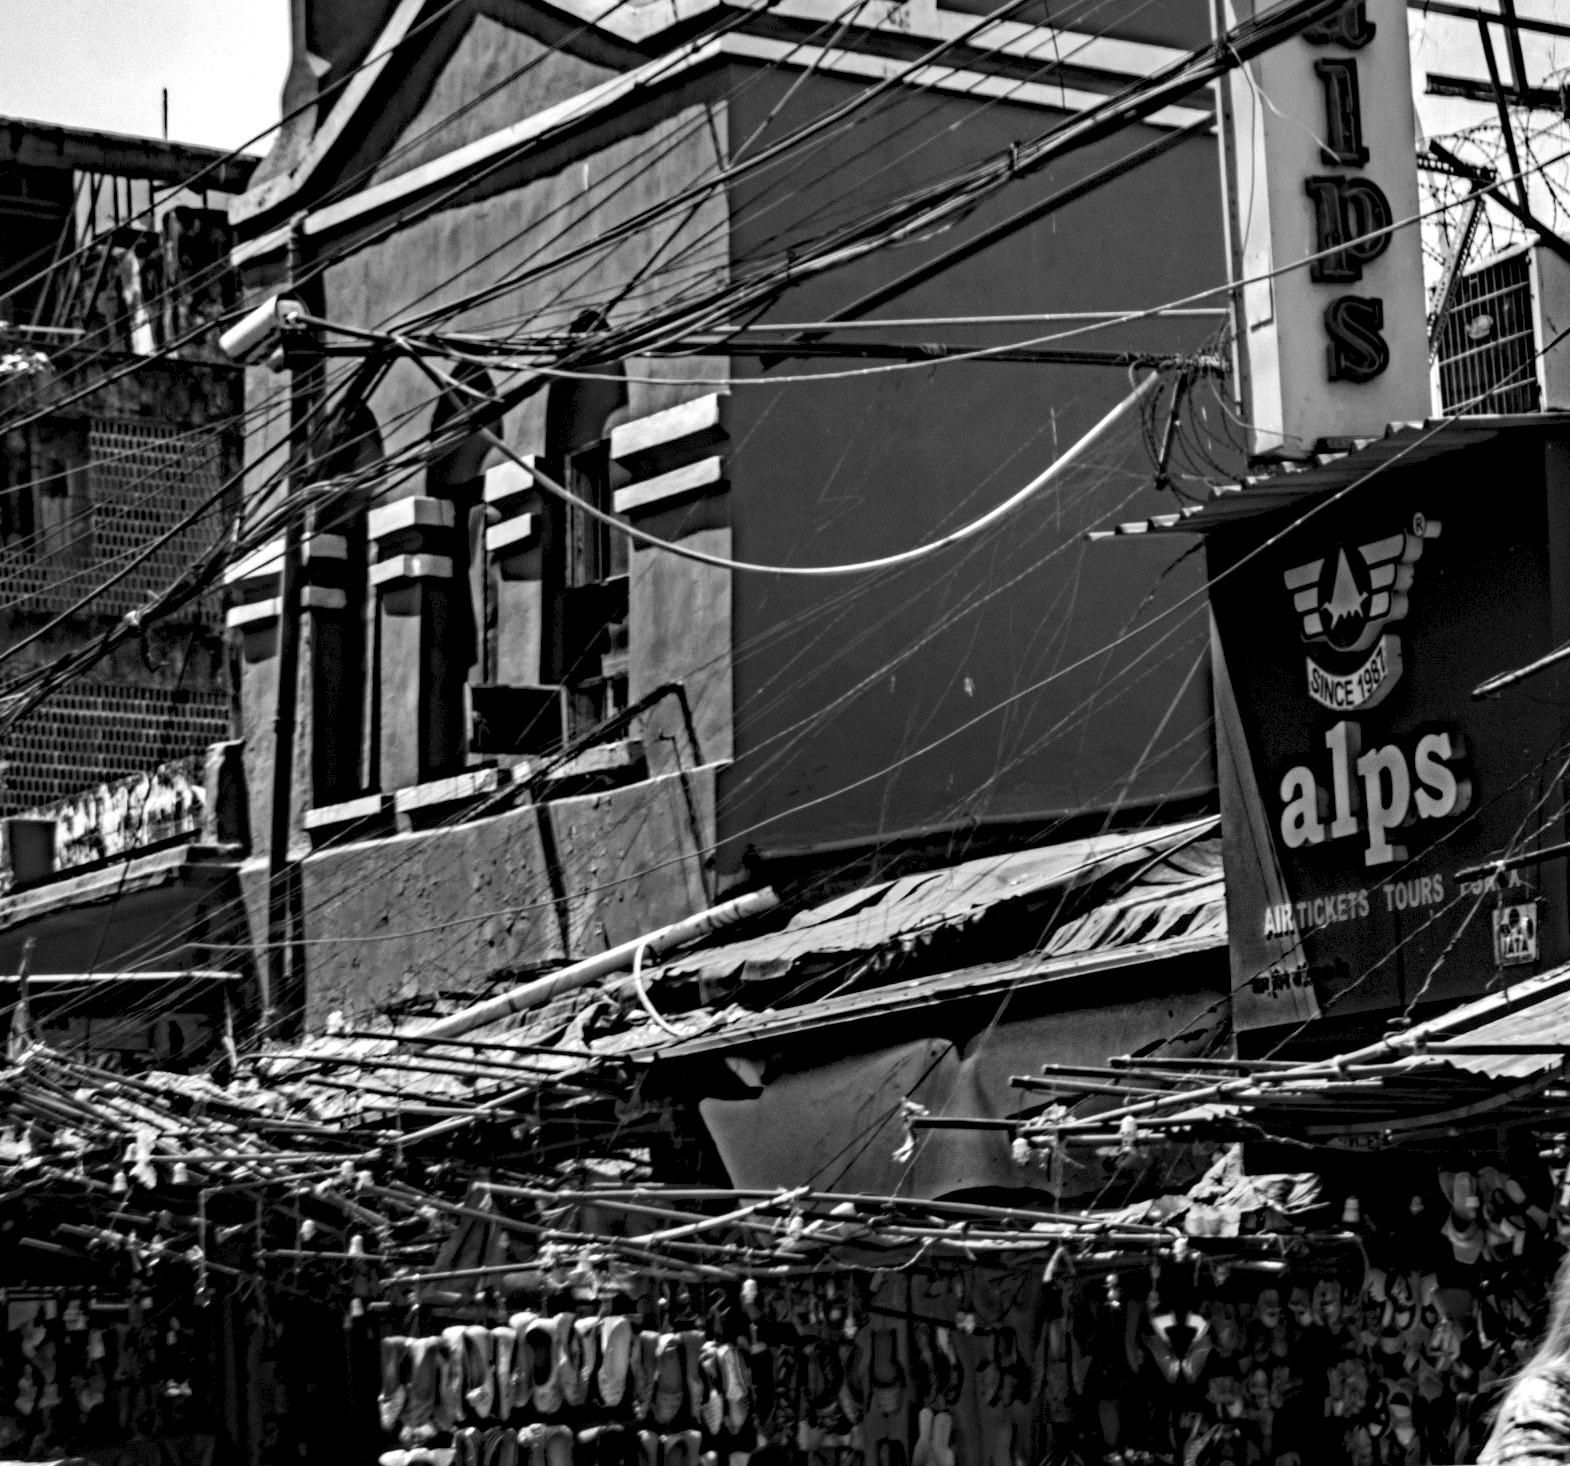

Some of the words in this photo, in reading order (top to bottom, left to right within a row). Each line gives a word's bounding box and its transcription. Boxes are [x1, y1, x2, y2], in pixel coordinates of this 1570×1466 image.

[1310, 667, 1355, 707] SINCE
[1358, 647, 1388, 695] 1987
[1279, 719, 1460, 867] alps
[1263, 902, 1296, 935] AIR
[1296, 889, 1370, 929] TICKETS
[1383, 874, 1444, 912] TOURS
